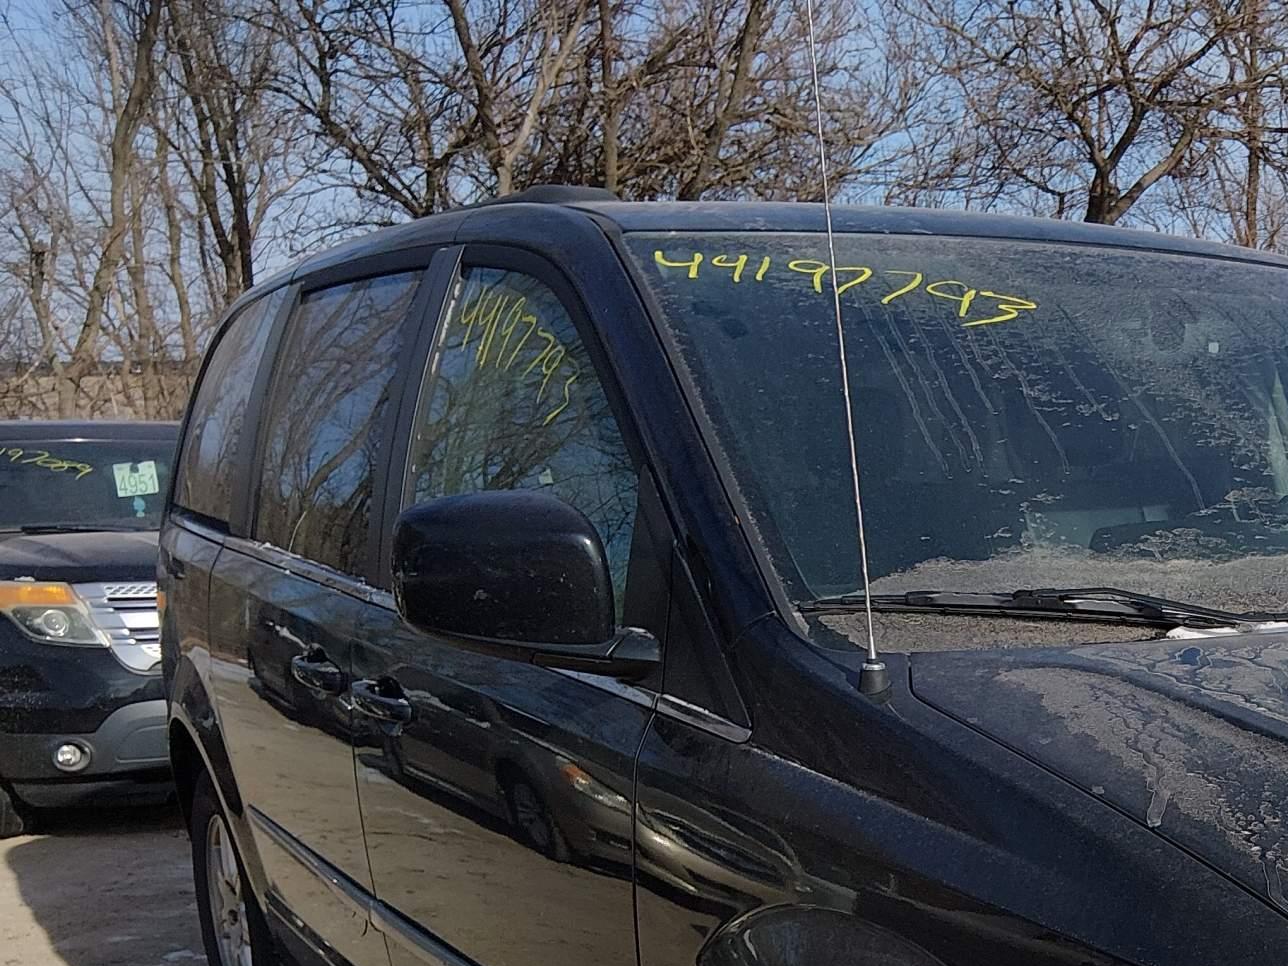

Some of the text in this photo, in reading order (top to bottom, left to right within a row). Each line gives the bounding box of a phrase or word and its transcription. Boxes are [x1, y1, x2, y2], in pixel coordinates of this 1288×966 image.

[654, 250, 1038, 327] 44197793
[460, 285, 581, 427] 44197793
[119, 473, 157, 495] 4951
